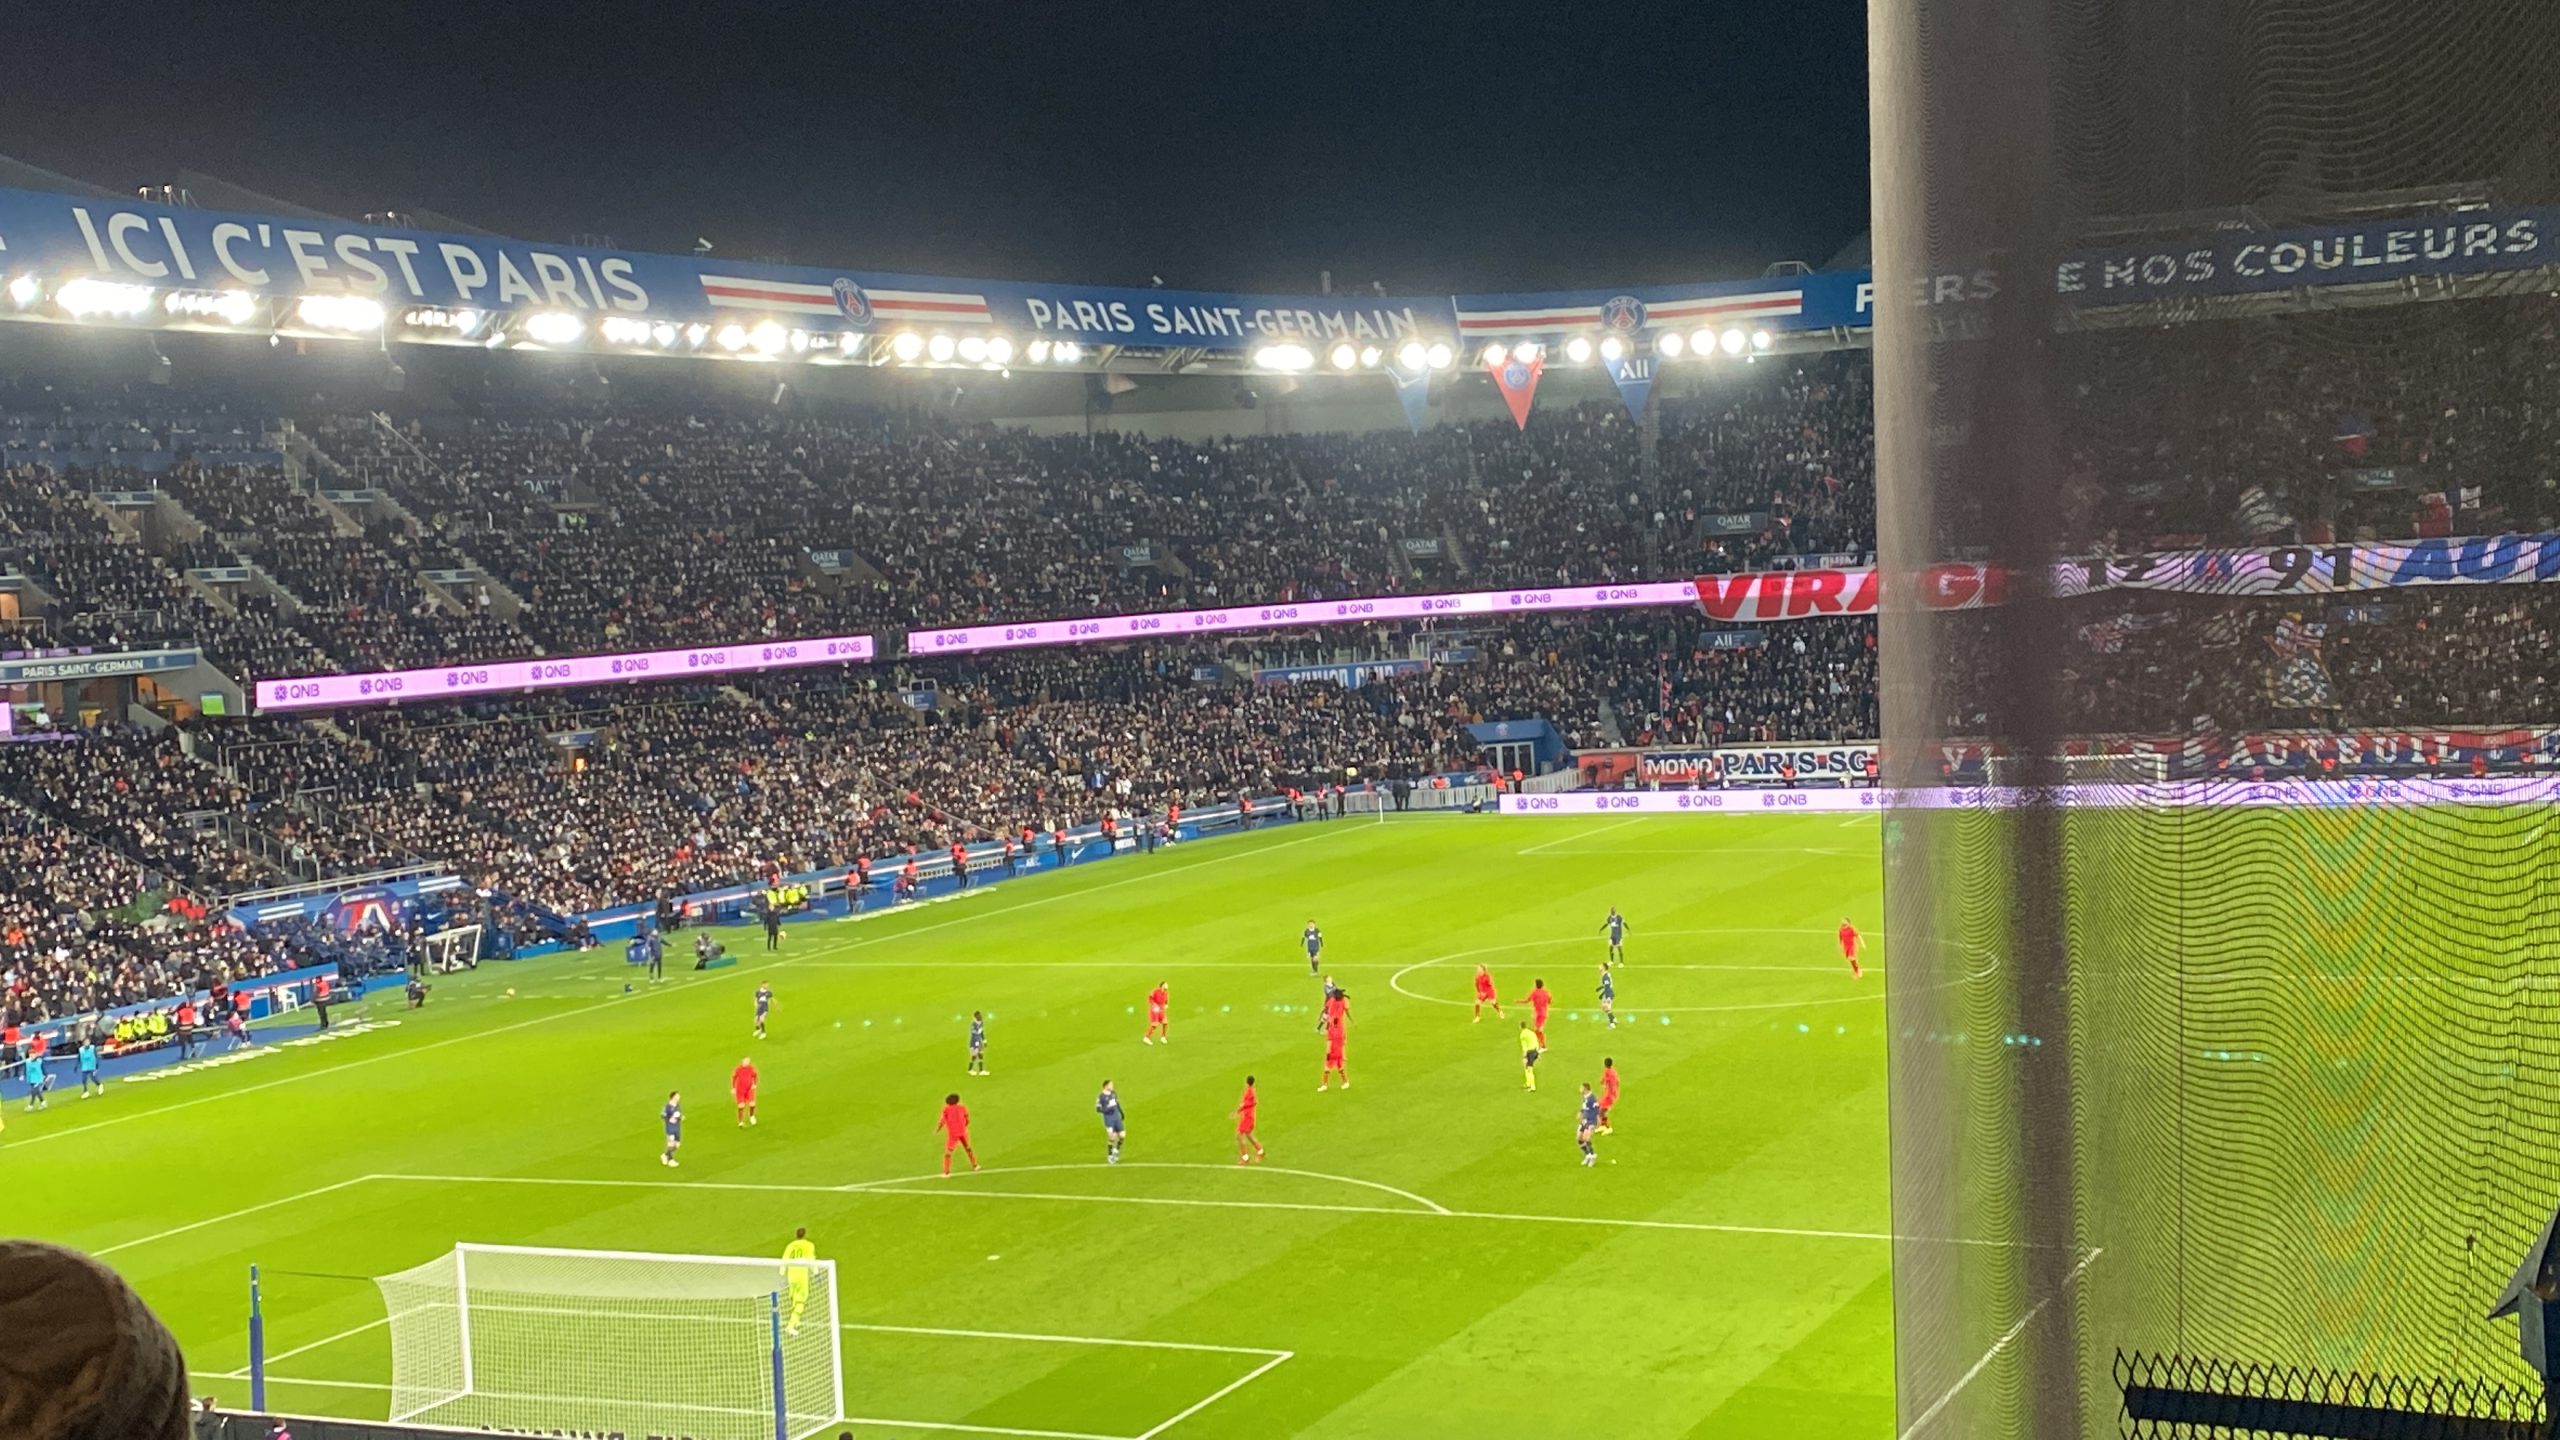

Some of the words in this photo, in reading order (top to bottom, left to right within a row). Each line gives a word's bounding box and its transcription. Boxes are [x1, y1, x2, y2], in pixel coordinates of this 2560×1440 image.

[73, 208, 195, 279] ICI
[212, 222, 424, 298] C'EST
[440, 242, 649, 313] PARIS
[2104, 249, 2216, 289] NOS
[2234, 219, 2540, 277] COULEURS
[1026, 297, 1135, 332] PARIS
[1146, 303, 1417, 341] SAINT-GERMAIN
[1717, 514, 1751, 527] QATAR
[1406, 540, 1438, 550] QATAR
[2269, 547, 2352, 591] 91
[1524, 593, 1552, 604] QNB
[1610, 588, 1638, 600] QNB
[1349, 602, 1374, 614] QNB
[1435, 598, 1461, 609] QNB
[1205, 613, 1228, 625] QNB
[1273, 607, 1298, 620] QNB
[1079, 622, 1100, 634] QNB
[1141, 618, 1161, 630] QNB
[947, 633, 968, 646] QNB
[1016, 628, 1037, 640] QNB
[774, 646, 797, 660] QNB
[839, 641, 862, 655] QNB
[625, 658, 649, 671] QNB
[701, 652, 726, 666] QNB
[22, 664, 56, 678] PARIS
[58, 658, 144, 675] SAINT-GERMAIN
[545, 665, 571, 678] QNB
[375, 678, 403, 692] QNB
[461, 671, 489, 686] QNB
[290, 684, 320, 699] QNB
[1644, 757, 1713, 776] MOMO
[1530, 795, 1558, 810] QNB
[1611, 795, 1640, 809] QNB
[1693, 794, 1722, 808] QNB
[1778, 794, 1808, 807] QNB
